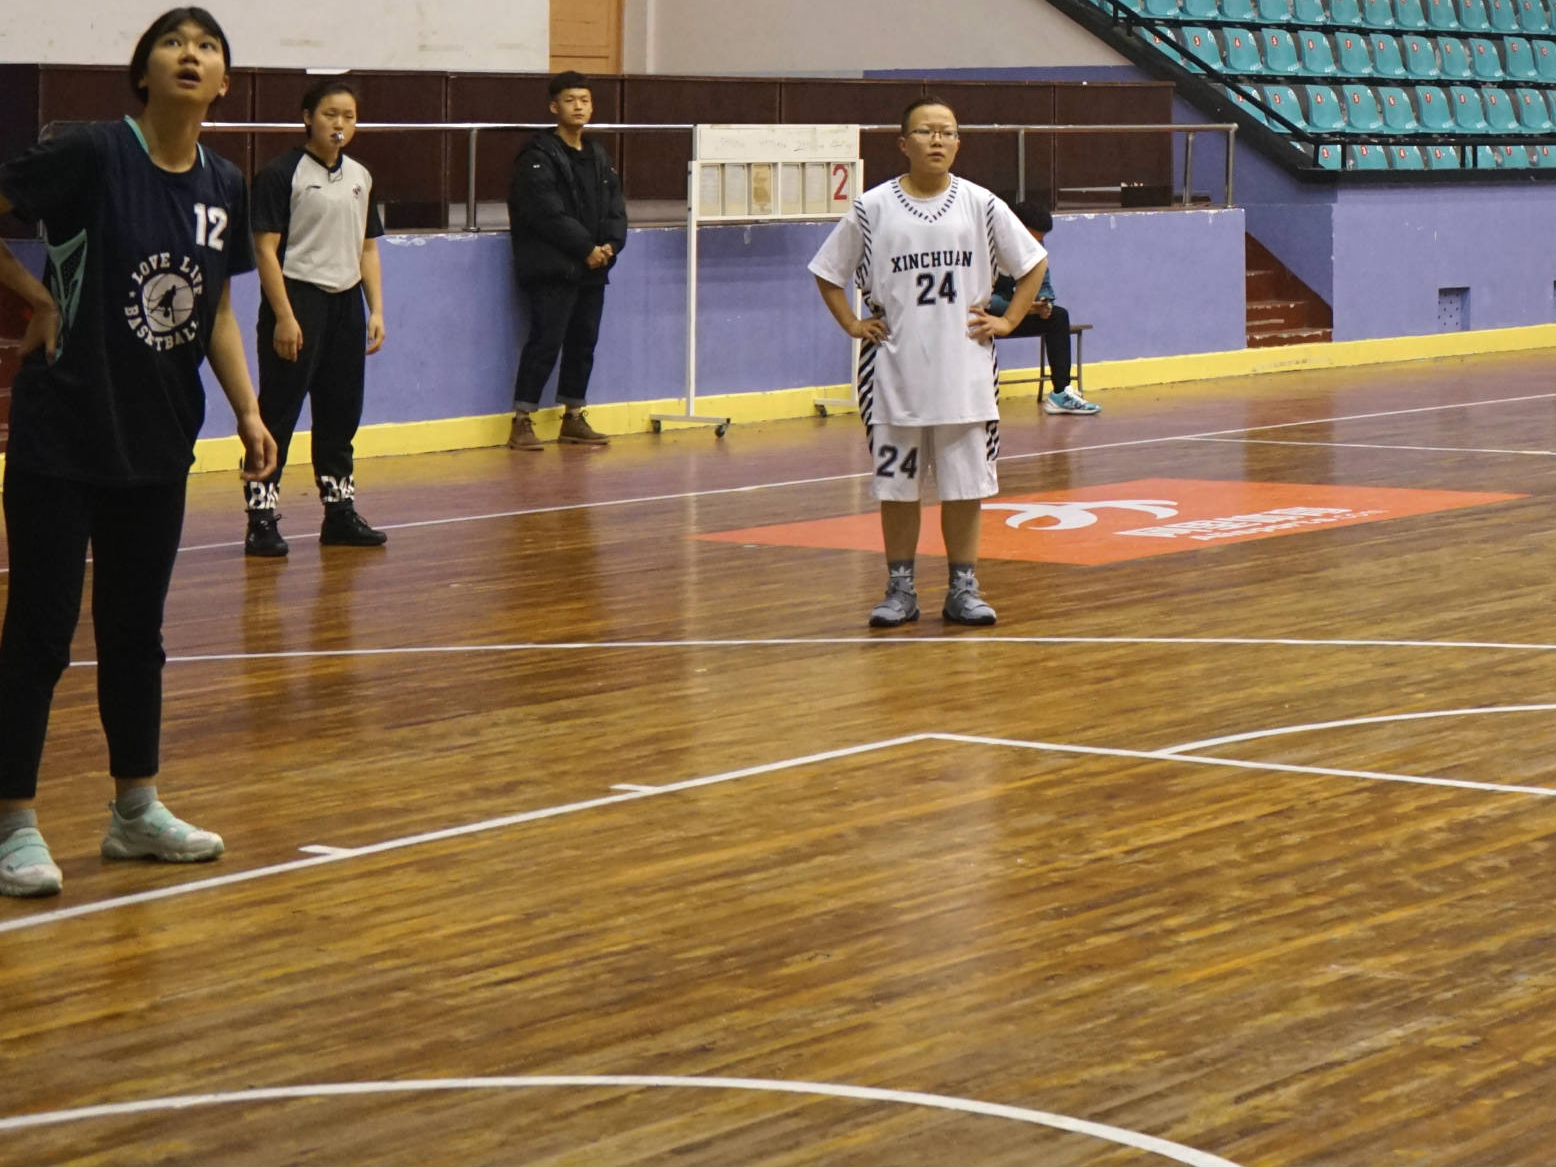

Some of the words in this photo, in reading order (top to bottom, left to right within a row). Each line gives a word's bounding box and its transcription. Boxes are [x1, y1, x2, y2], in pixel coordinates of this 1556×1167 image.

[832, 163, 849, 201] 2
[193, 202, 228, 251] 12
[131, 252, 171, 285] LOVE
[891, 250, 973, 273] XINCHUAN
[916, 271, 957, 306] 24
[876, 444, 919, 479] 24
